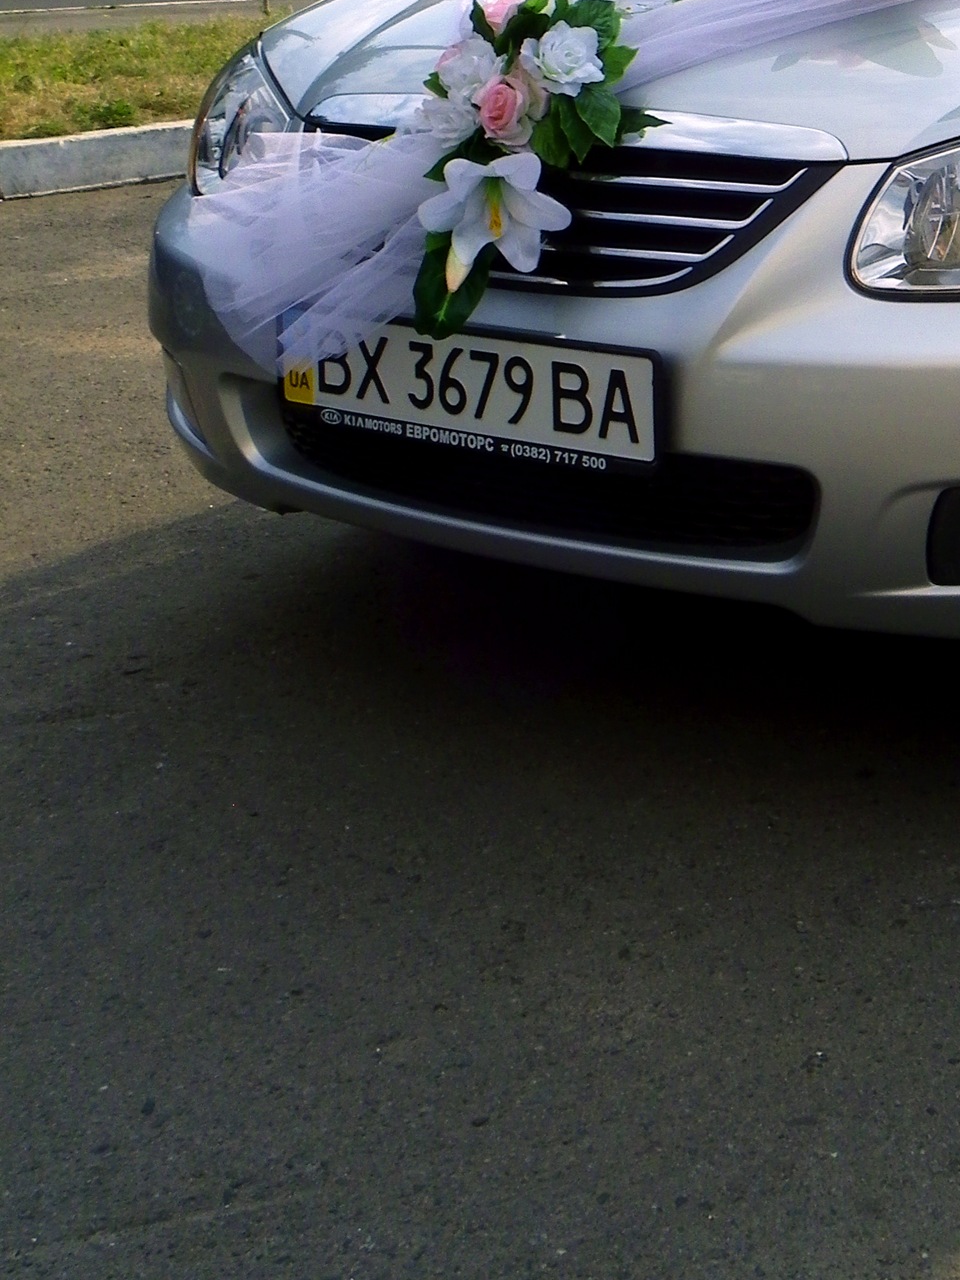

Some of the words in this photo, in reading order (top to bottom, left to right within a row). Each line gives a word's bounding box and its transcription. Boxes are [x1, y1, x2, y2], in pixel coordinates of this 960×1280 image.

[289, 369, 311, 391] UA
[407, 340, 534, 425] 3679
[551, 360, 640, 444] BA
[406, 424, 495, 452] ЕВРОМОТОРС
[510, 443, 551, 463] (0382)
[554, 450, 578, 465] 717
[581, 455, 607, 470] 500
